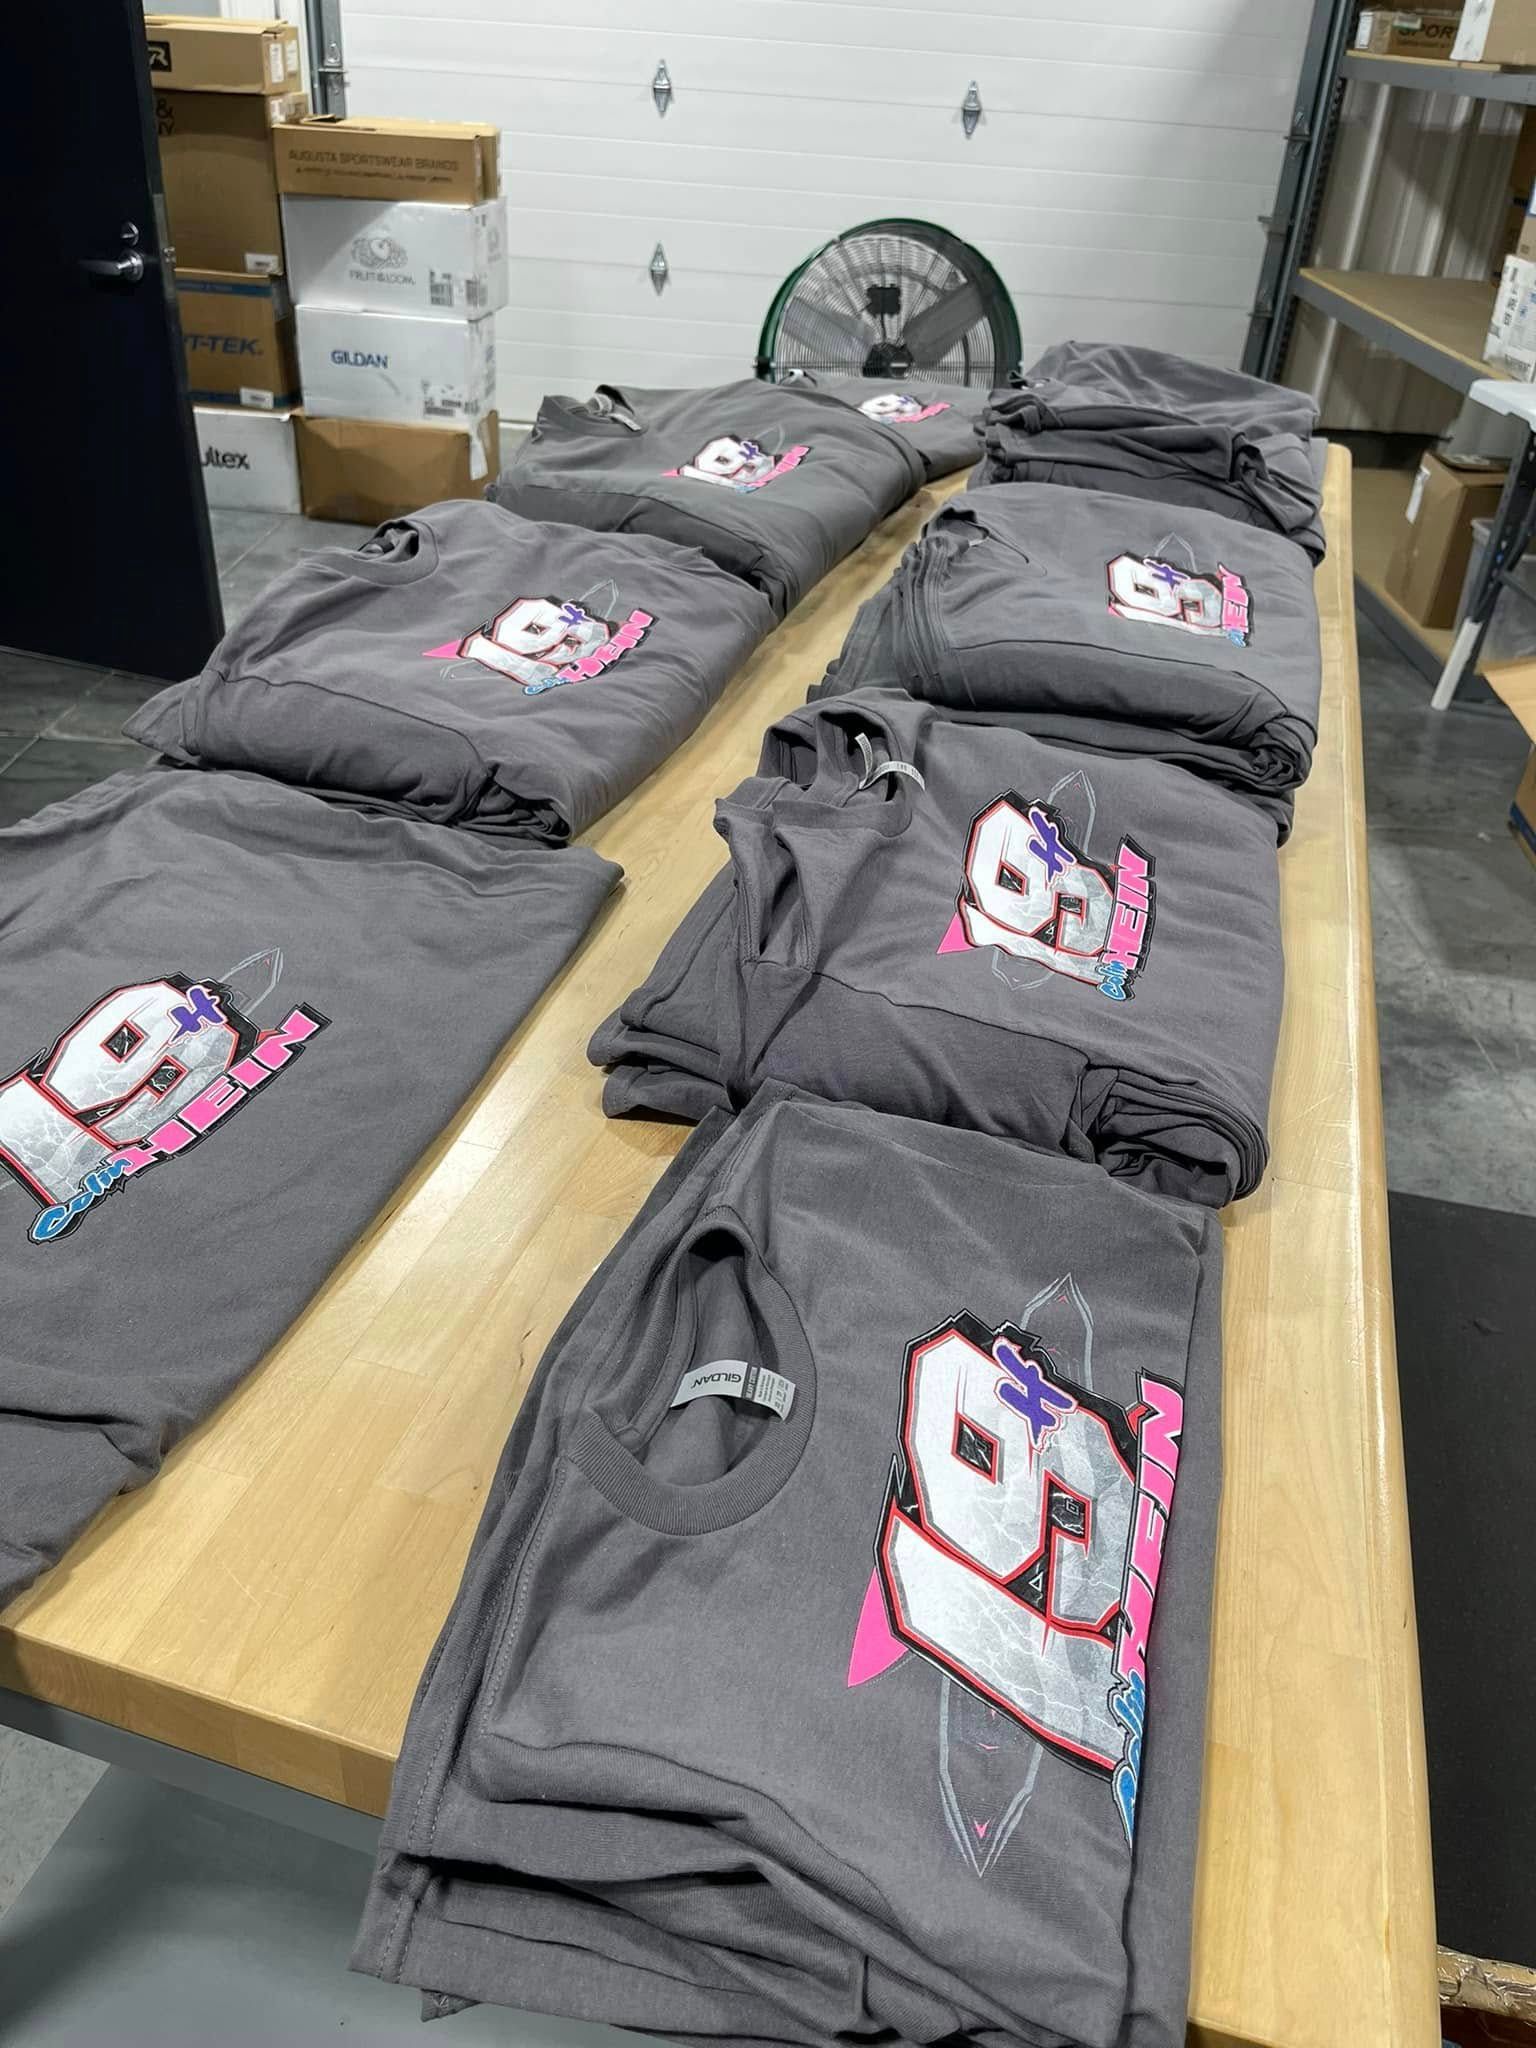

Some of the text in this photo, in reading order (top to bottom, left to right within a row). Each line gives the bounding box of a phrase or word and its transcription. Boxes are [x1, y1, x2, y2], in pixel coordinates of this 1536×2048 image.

[289, 150, 459, 172] AUGUSTA SPORTSWEAR BRANDS
[331, 350, 388, 368] GILDAN
[201, 446, 249, 470] ultex
[957, 800, 1115, 988] 19
[1102, 843, 1151, 970] HEIN
[105, 1008, 321, 1177] HEIN
[690, 1372, 741, 1389] GILDAN
[994, 1336, 1079, 1455] H
[880, 1326, 1138, 1772] 19
